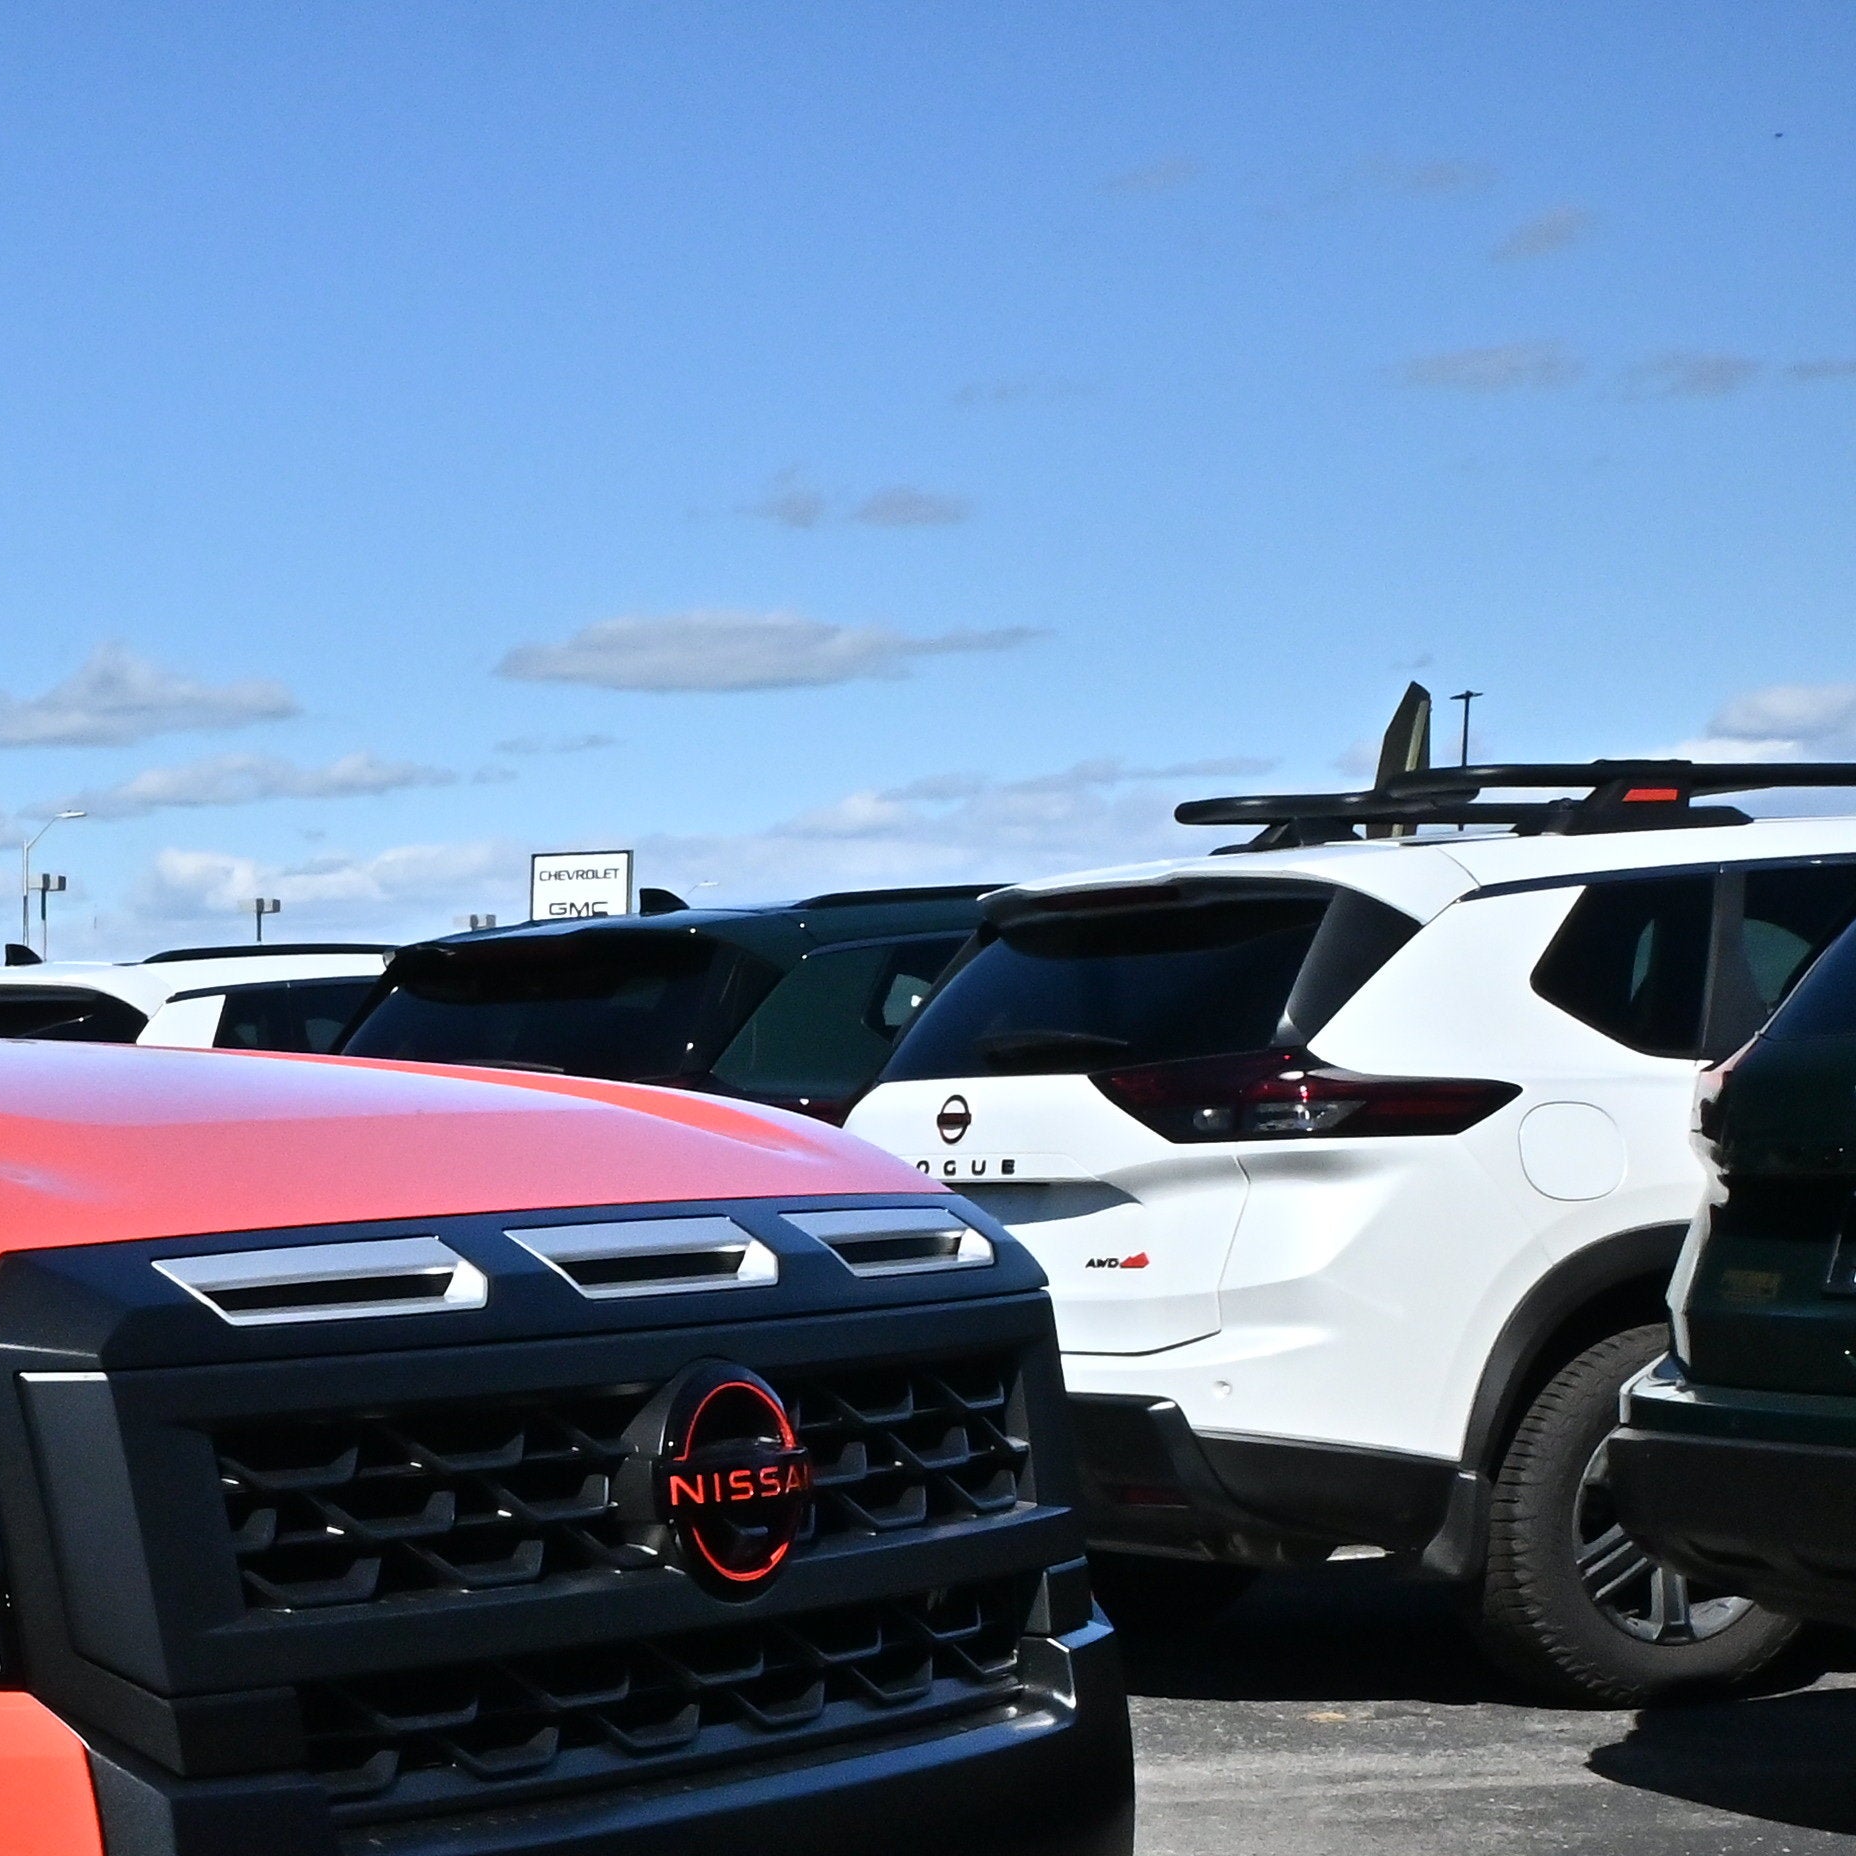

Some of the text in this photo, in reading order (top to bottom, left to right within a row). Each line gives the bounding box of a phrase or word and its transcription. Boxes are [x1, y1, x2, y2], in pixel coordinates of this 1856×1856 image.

[539, 868, 620, 881] CHEVROLET
[549, 902, 608, 917] GMC
[916, 1159, 1016, 1176] OGUE
[1085, 1257, 1119, 1268] AWD
